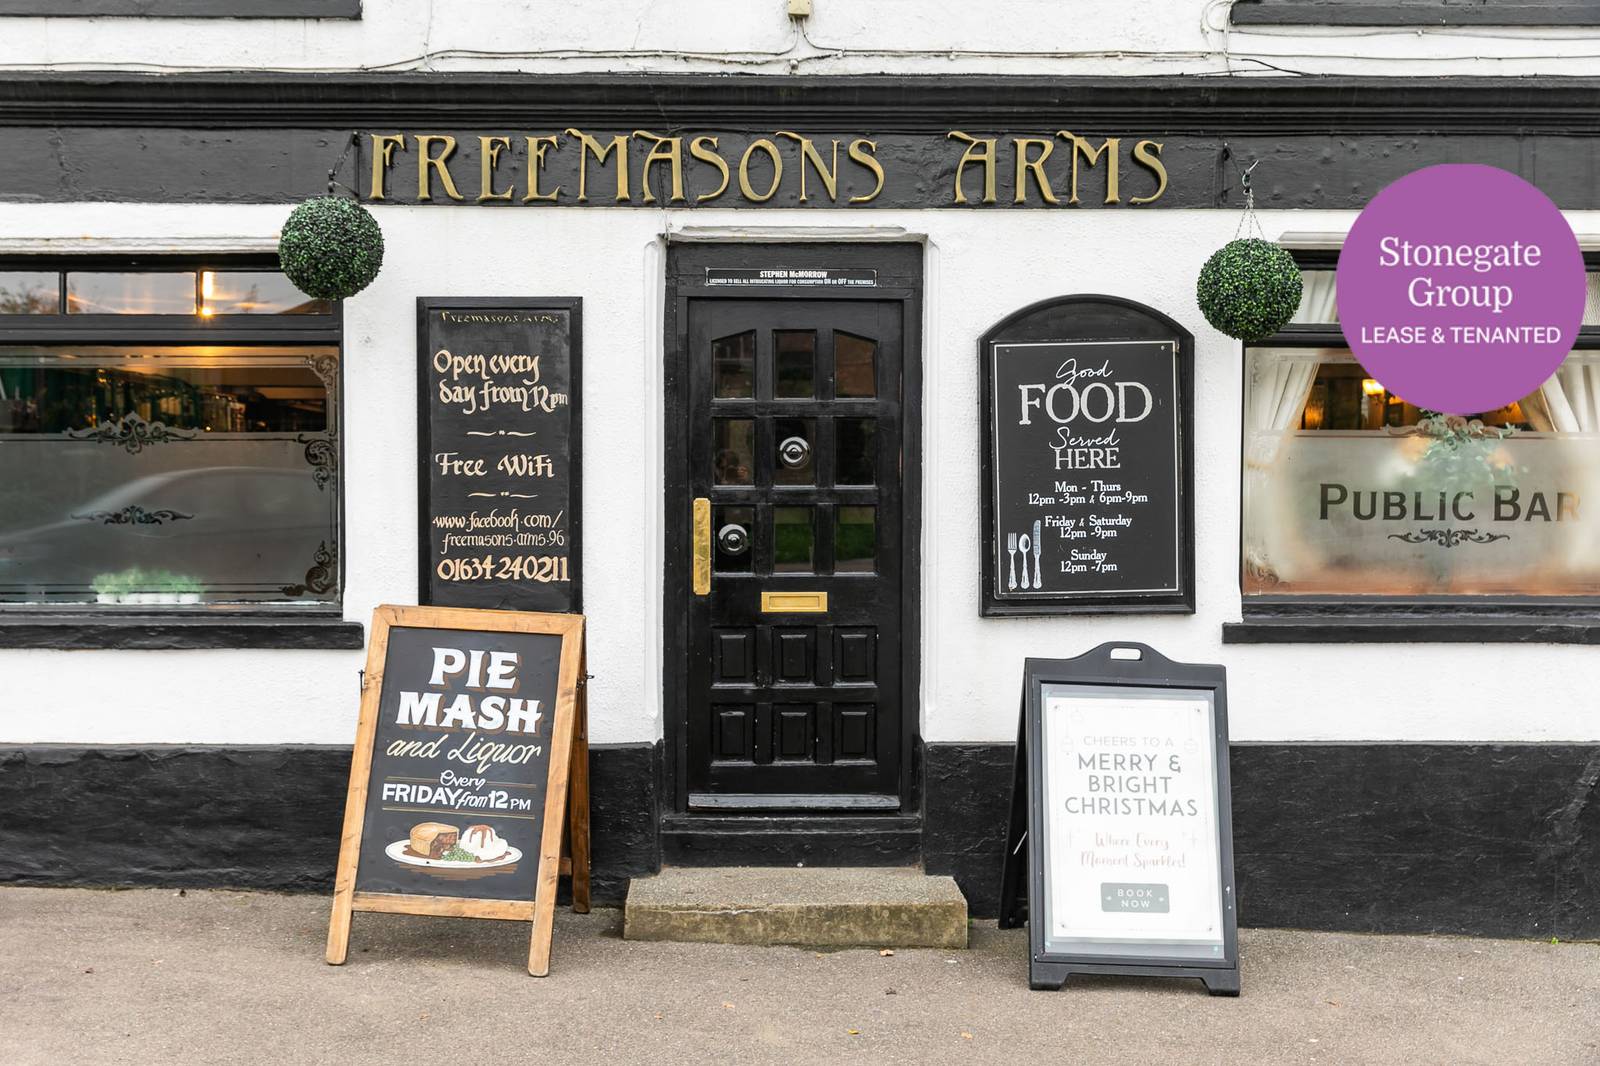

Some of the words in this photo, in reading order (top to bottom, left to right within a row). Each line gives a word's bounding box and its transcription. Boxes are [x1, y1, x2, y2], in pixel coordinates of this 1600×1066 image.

[369, 127, 885, 202] FREEMASONS
[946, 129, 1169, 205] ARMS
[433, 350, 490, 381] Open
[489, 354, 540, 385] every
[1055, 358, 1113, 389] Good
[439, 378, 476, 415] day
[479, 380, 532, 412] from
[1018, 381, 1153, 425] FOOD
[1049, 426, 1120, 450] Served
[435, 452, 488, 476] Free
[497, 454, 555, 478] WiFi
[1054, 447, 1120, 470] HERE
[1054, 481, 1078, 493] Mon
[1090, 480, 1121, 492] Thurs
[1028, 493, 1055, 506] 12pm
[1044, 515, 1076, 529] Friday
[1089, 514, 1132, 528] Saturday
[1060, 527, 1087, 540] 12pm
[1070, 549, 1107, 562] Sunday
[437, 554, 496, 582] 01634
[495, 555, 571, 583] 240211
[1060, 561, 1087, 574] 12pm
[428, 647, 520, 691] PIE
[395, 691, 544, 735] MASH
[386, 734, 449, 758] and
[447, 732, 542, 774] Liquor
[1083, 736, 1137, 748] CHEERS
[1142, 736, 1161, 748] TO
[1164, 737, 1174, 748] A
[1078, 753, 1158, 772] MERRY
[1169, 754, 1181, 773] &
[1088, 775, 1172, 794] BRIGHT
[382, 783, 460, 806] FRIDAY
[456, 789, 488, 810] from
[1065, 796, 1198, 817] CHRISTMAS
[1117, 889, 1153, 898] BOOK
[1121, 900, 1151, 909] NOW
